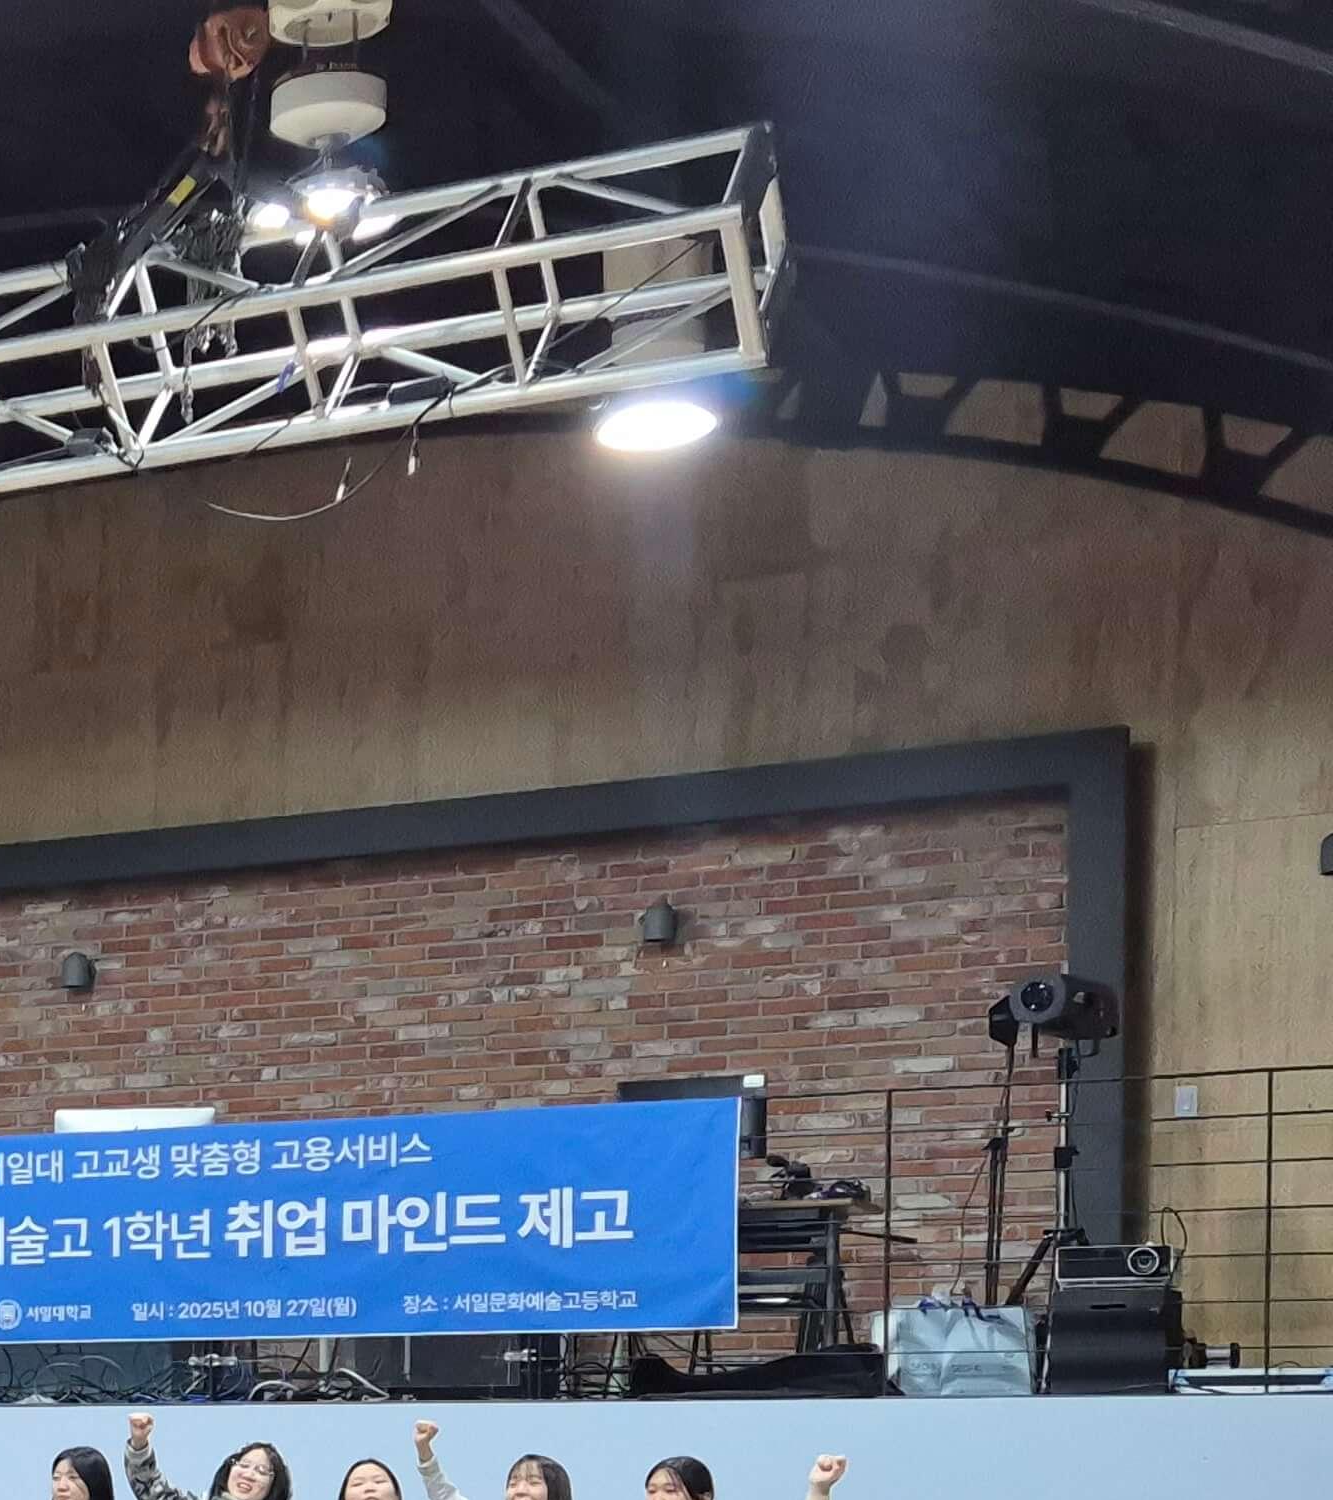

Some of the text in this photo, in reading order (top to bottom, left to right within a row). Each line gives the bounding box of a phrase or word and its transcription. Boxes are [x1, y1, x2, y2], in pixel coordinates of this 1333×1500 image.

[72, 1145, 161, 1180] 고교생
[170, 1139, 261, 1178] 맞춤형
[271, 1132, 433, 1172] 고용서비스
[102, 1208, 212, 1262] 1학년
[224, 1197, 327, 1259] 취업
[341, 1191, 507, 1255] 마인드
[517, 1187, 634, 1249] 제고
[25, 1304, 92, 1323] 서일대학교
[178, 1300, 240, 1320] 2025년
[244, 1299, 282, 1319] 10월
[286, 1296, 358, 1318] 27일(월)
[453, 1290, 638, 1314] 서일문화예술고등학교
